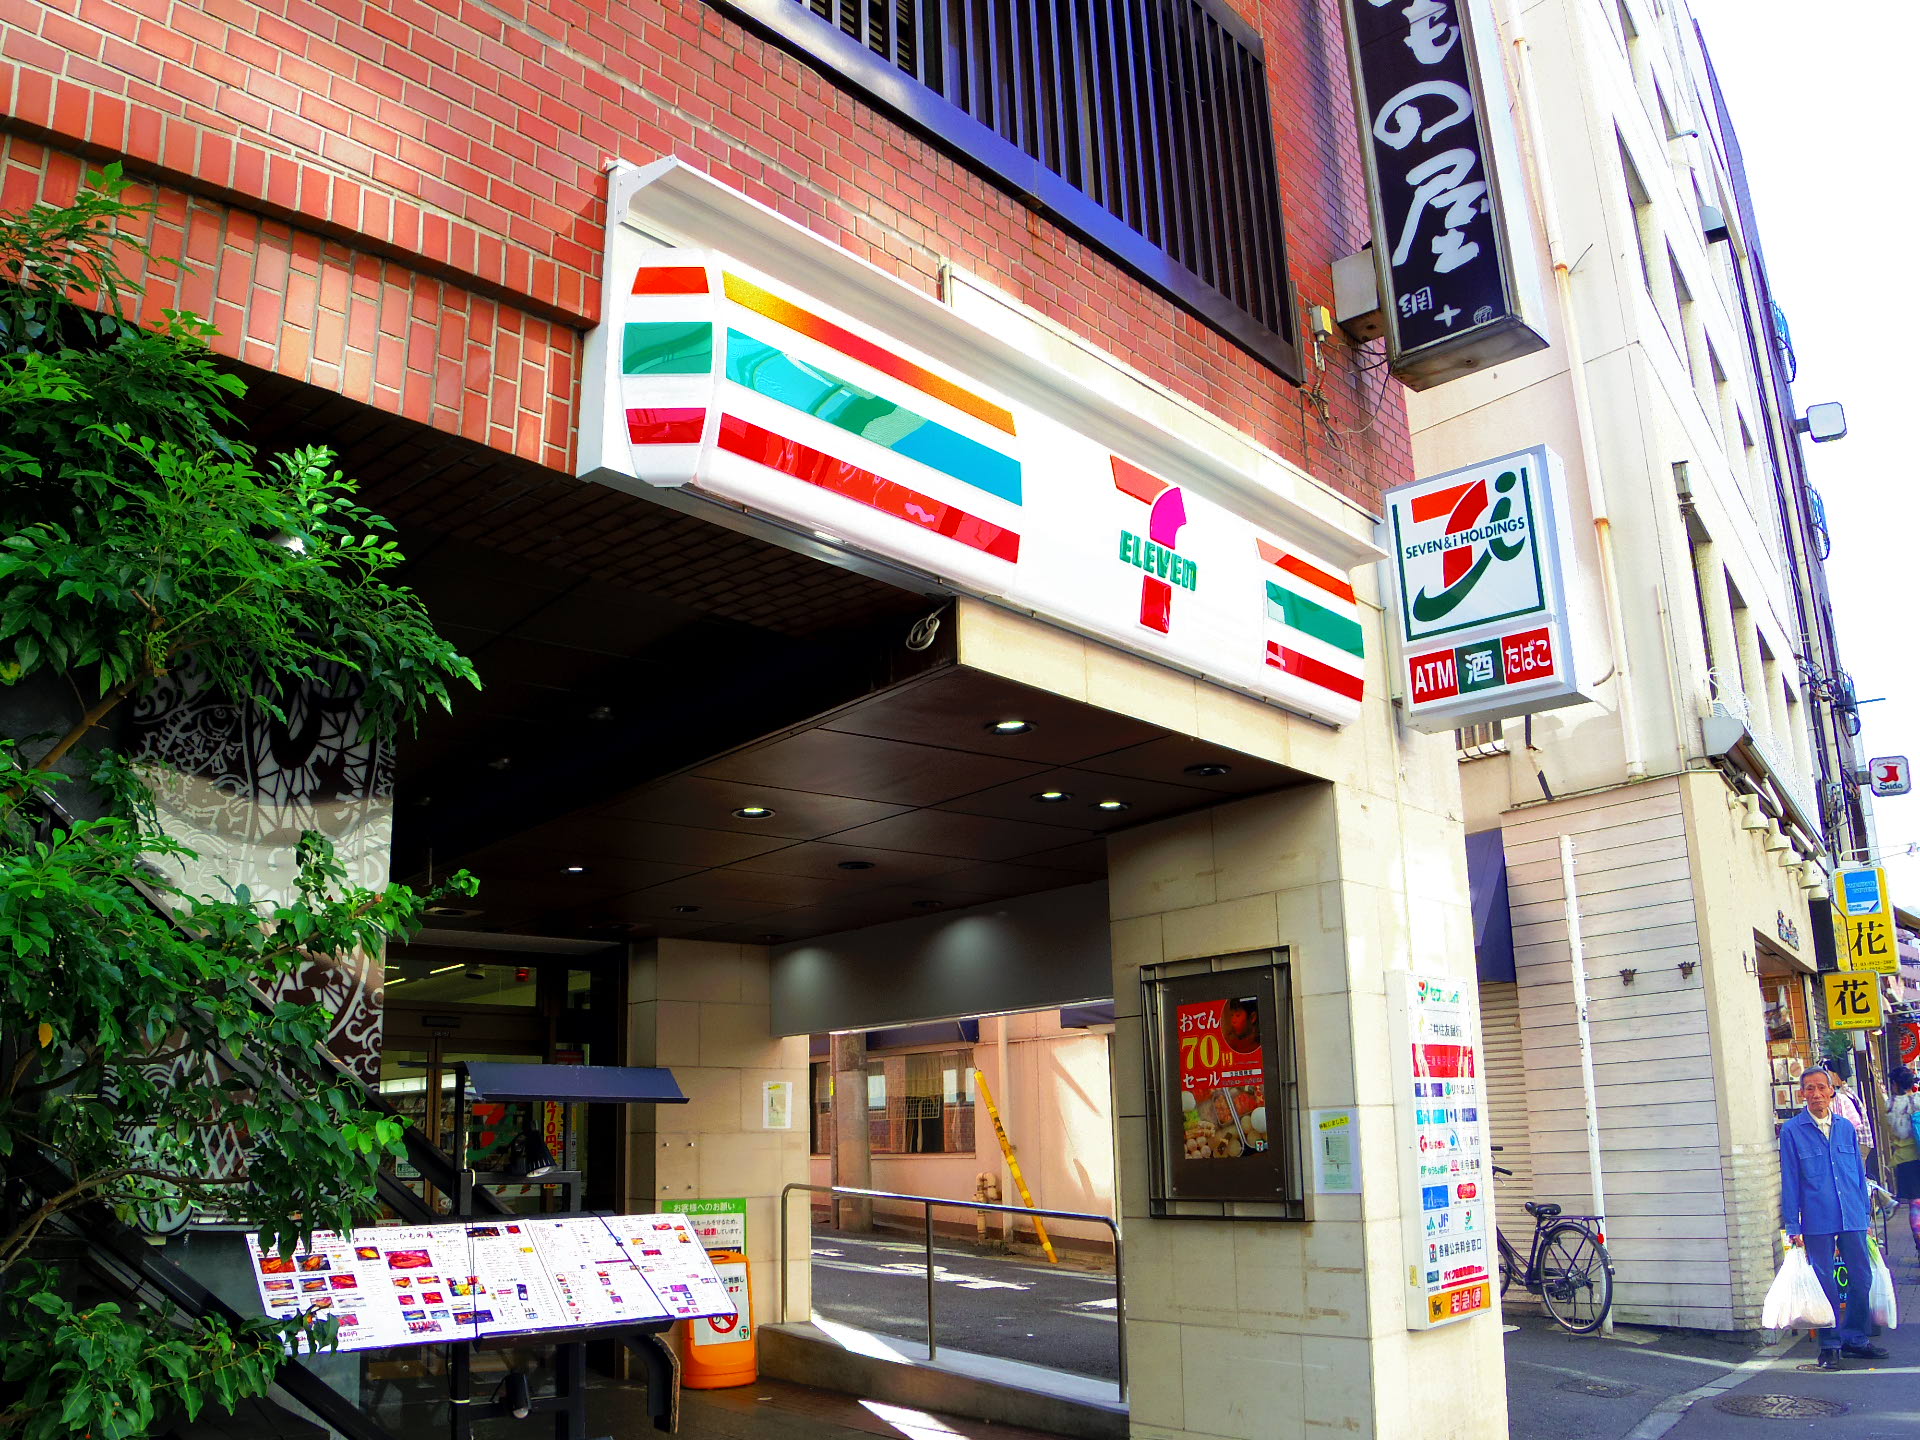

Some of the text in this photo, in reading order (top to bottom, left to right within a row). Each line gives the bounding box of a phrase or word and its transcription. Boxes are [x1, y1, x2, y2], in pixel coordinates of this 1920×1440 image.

[1368, 0, 1489, 273] もの屋
[1460, 517, 1525, 545] HOLDINGS
[1466, 650, 1494, 685] 酒
[1506, 640, 1551, 675] たばこ
[1415, 659, 1455, 694] ATM
[1848, 921, 1888, 957] 花
[1833, 980, 1870, 1015] 花
[1180, 1010, 1220, 1032] おでん
[1183, 1071, 1220, 1088] セール
[673, 1202, 735, 1212] お客様へのお願い
[1452, 1287, 1481, 1313] 宅急便
